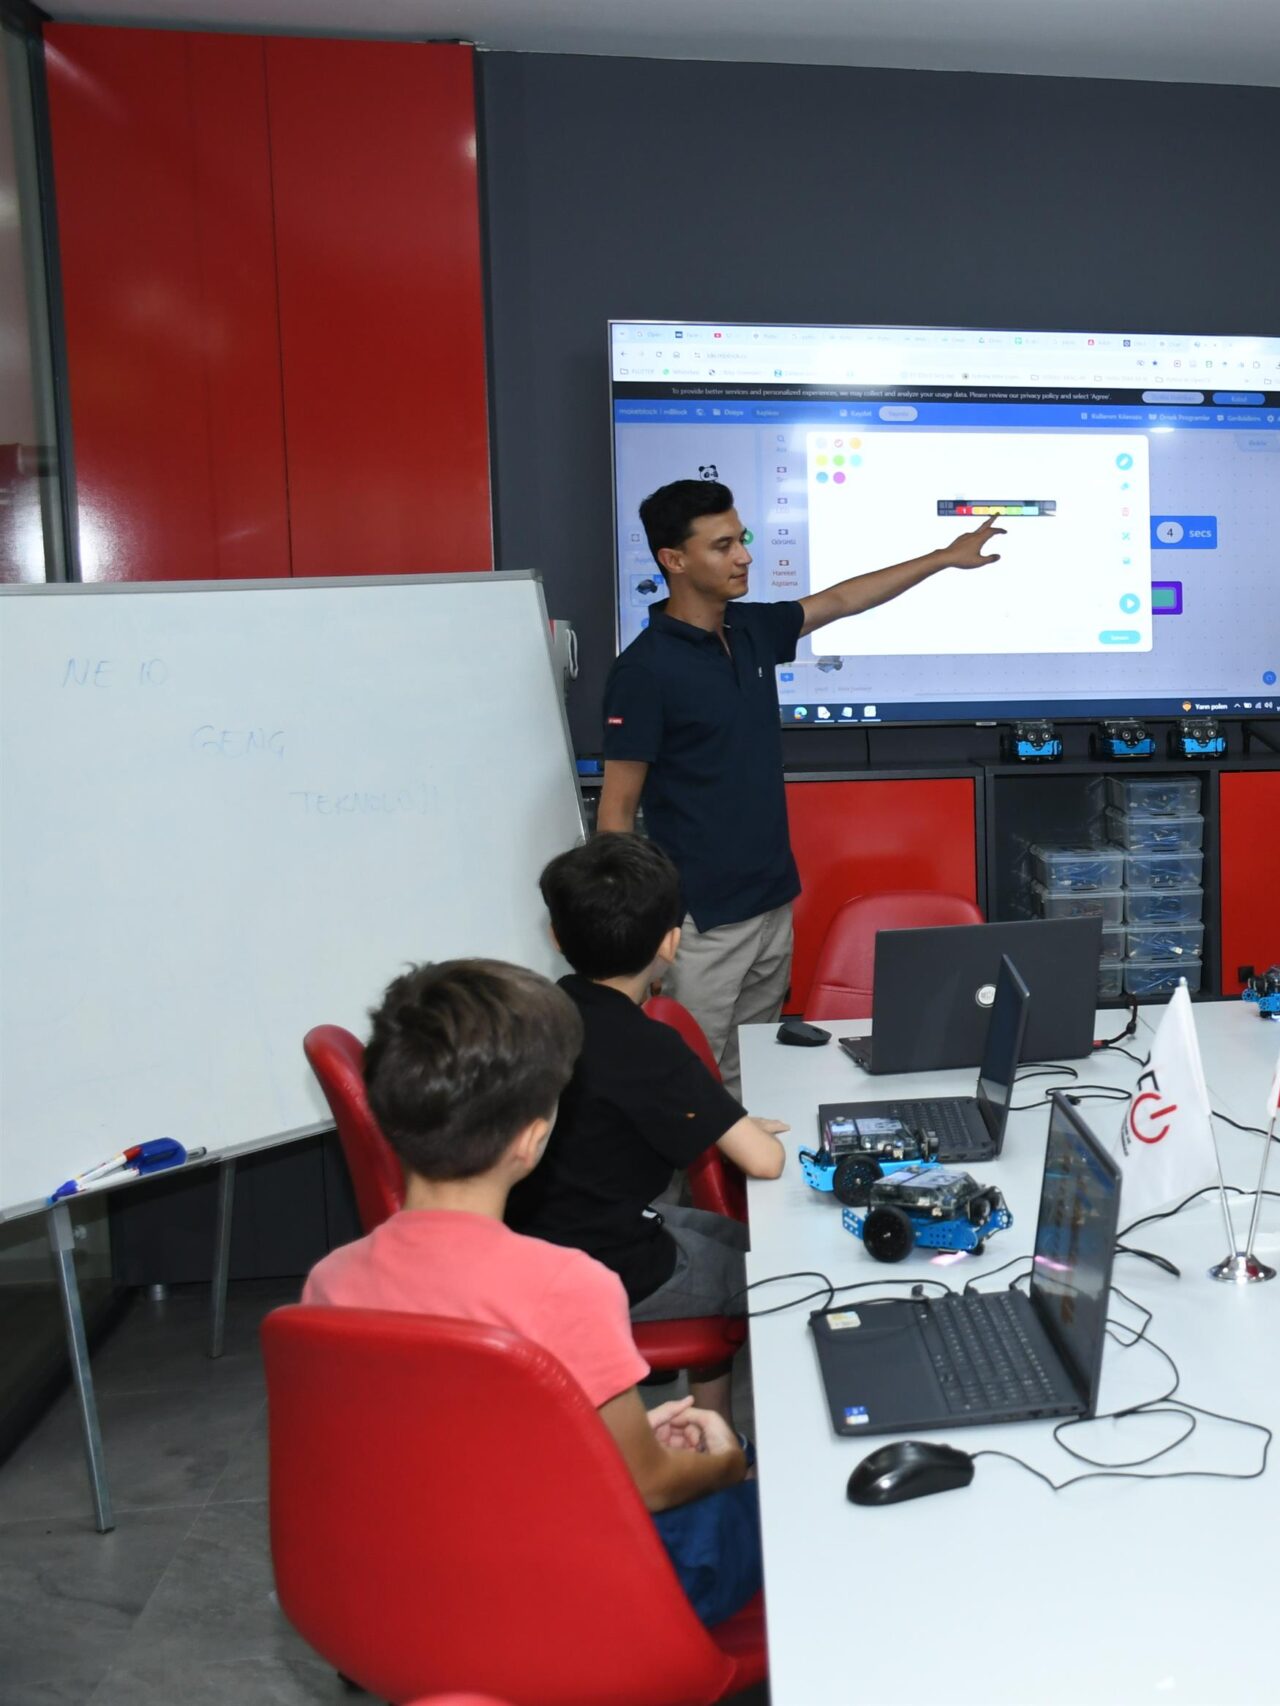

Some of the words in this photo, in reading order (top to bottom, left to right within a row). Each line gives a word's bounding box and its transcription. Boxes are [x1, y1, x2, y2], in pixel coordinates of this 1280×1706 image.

[680, 388, 704, 396] provide
[763, 388, 801, 397] personalized
[897, 390, 919, 398] analyze
[1020, 392, 1041, 400] privacy
[1042, 392, 1059, 400] policy
[1166, 527, 1174, 538] 4
[1188, 529, 1212, 539] secs
